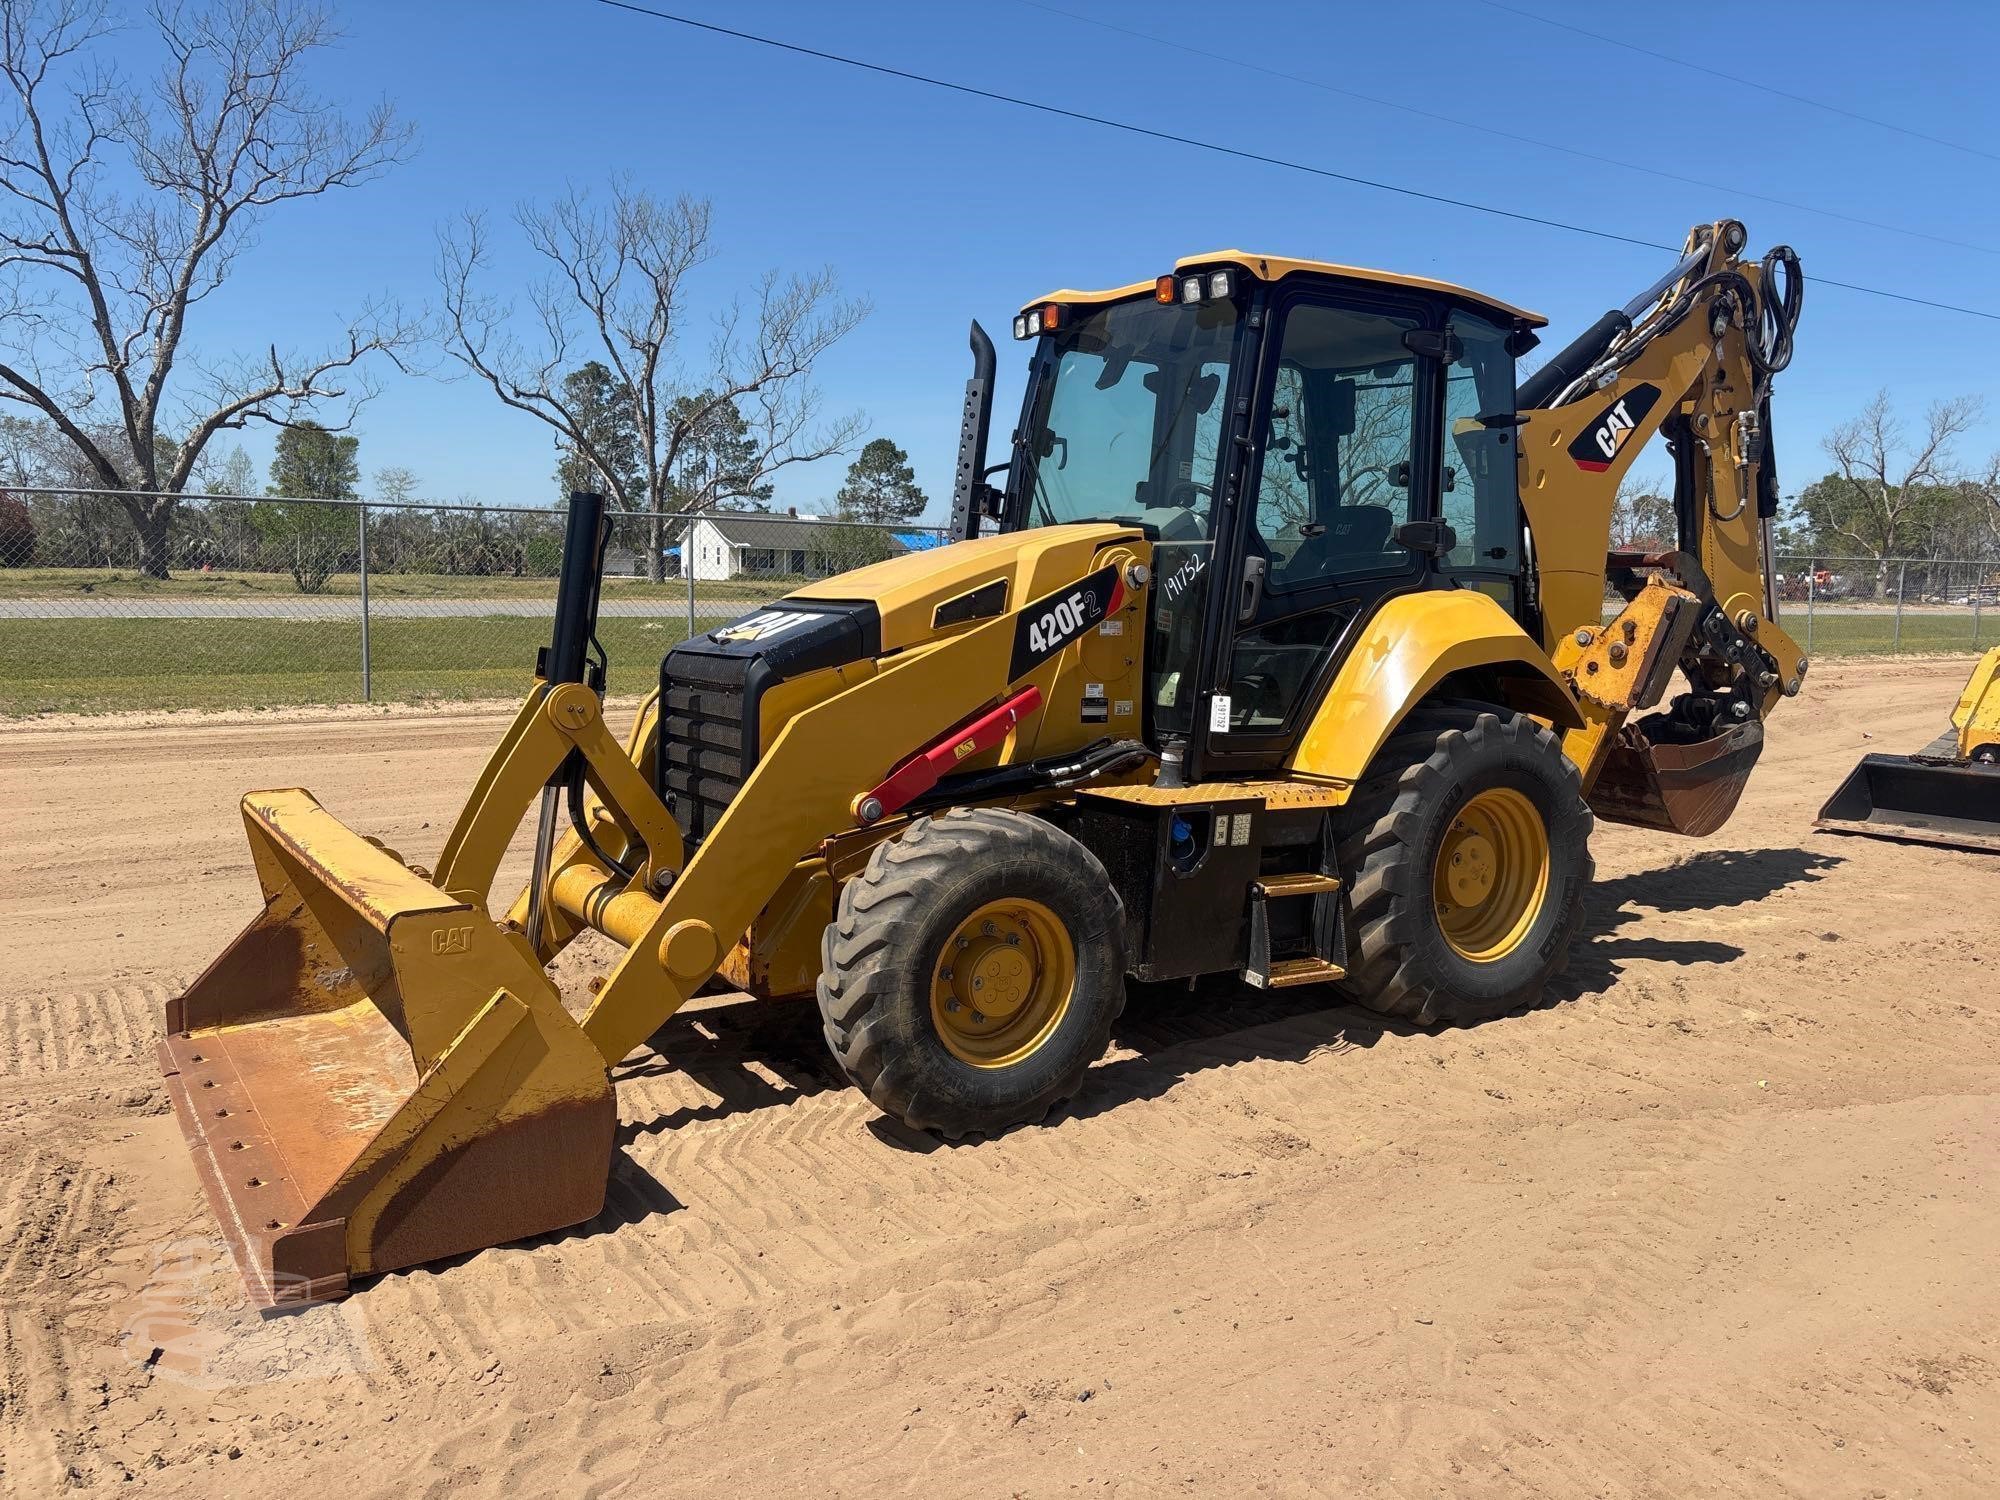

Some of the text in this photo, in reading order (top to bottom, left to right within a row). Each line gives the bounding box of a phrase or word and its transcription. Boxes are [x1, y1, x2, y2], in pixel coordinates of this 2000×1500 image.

[1595, 399, 1635, 458] CAT
[1164, 553, 1205, 602] 191752
[714, 610, 827, 642] CAT
[1216, 704, 1227, 729] 191752
[431, 926, 474, 955] CAT
